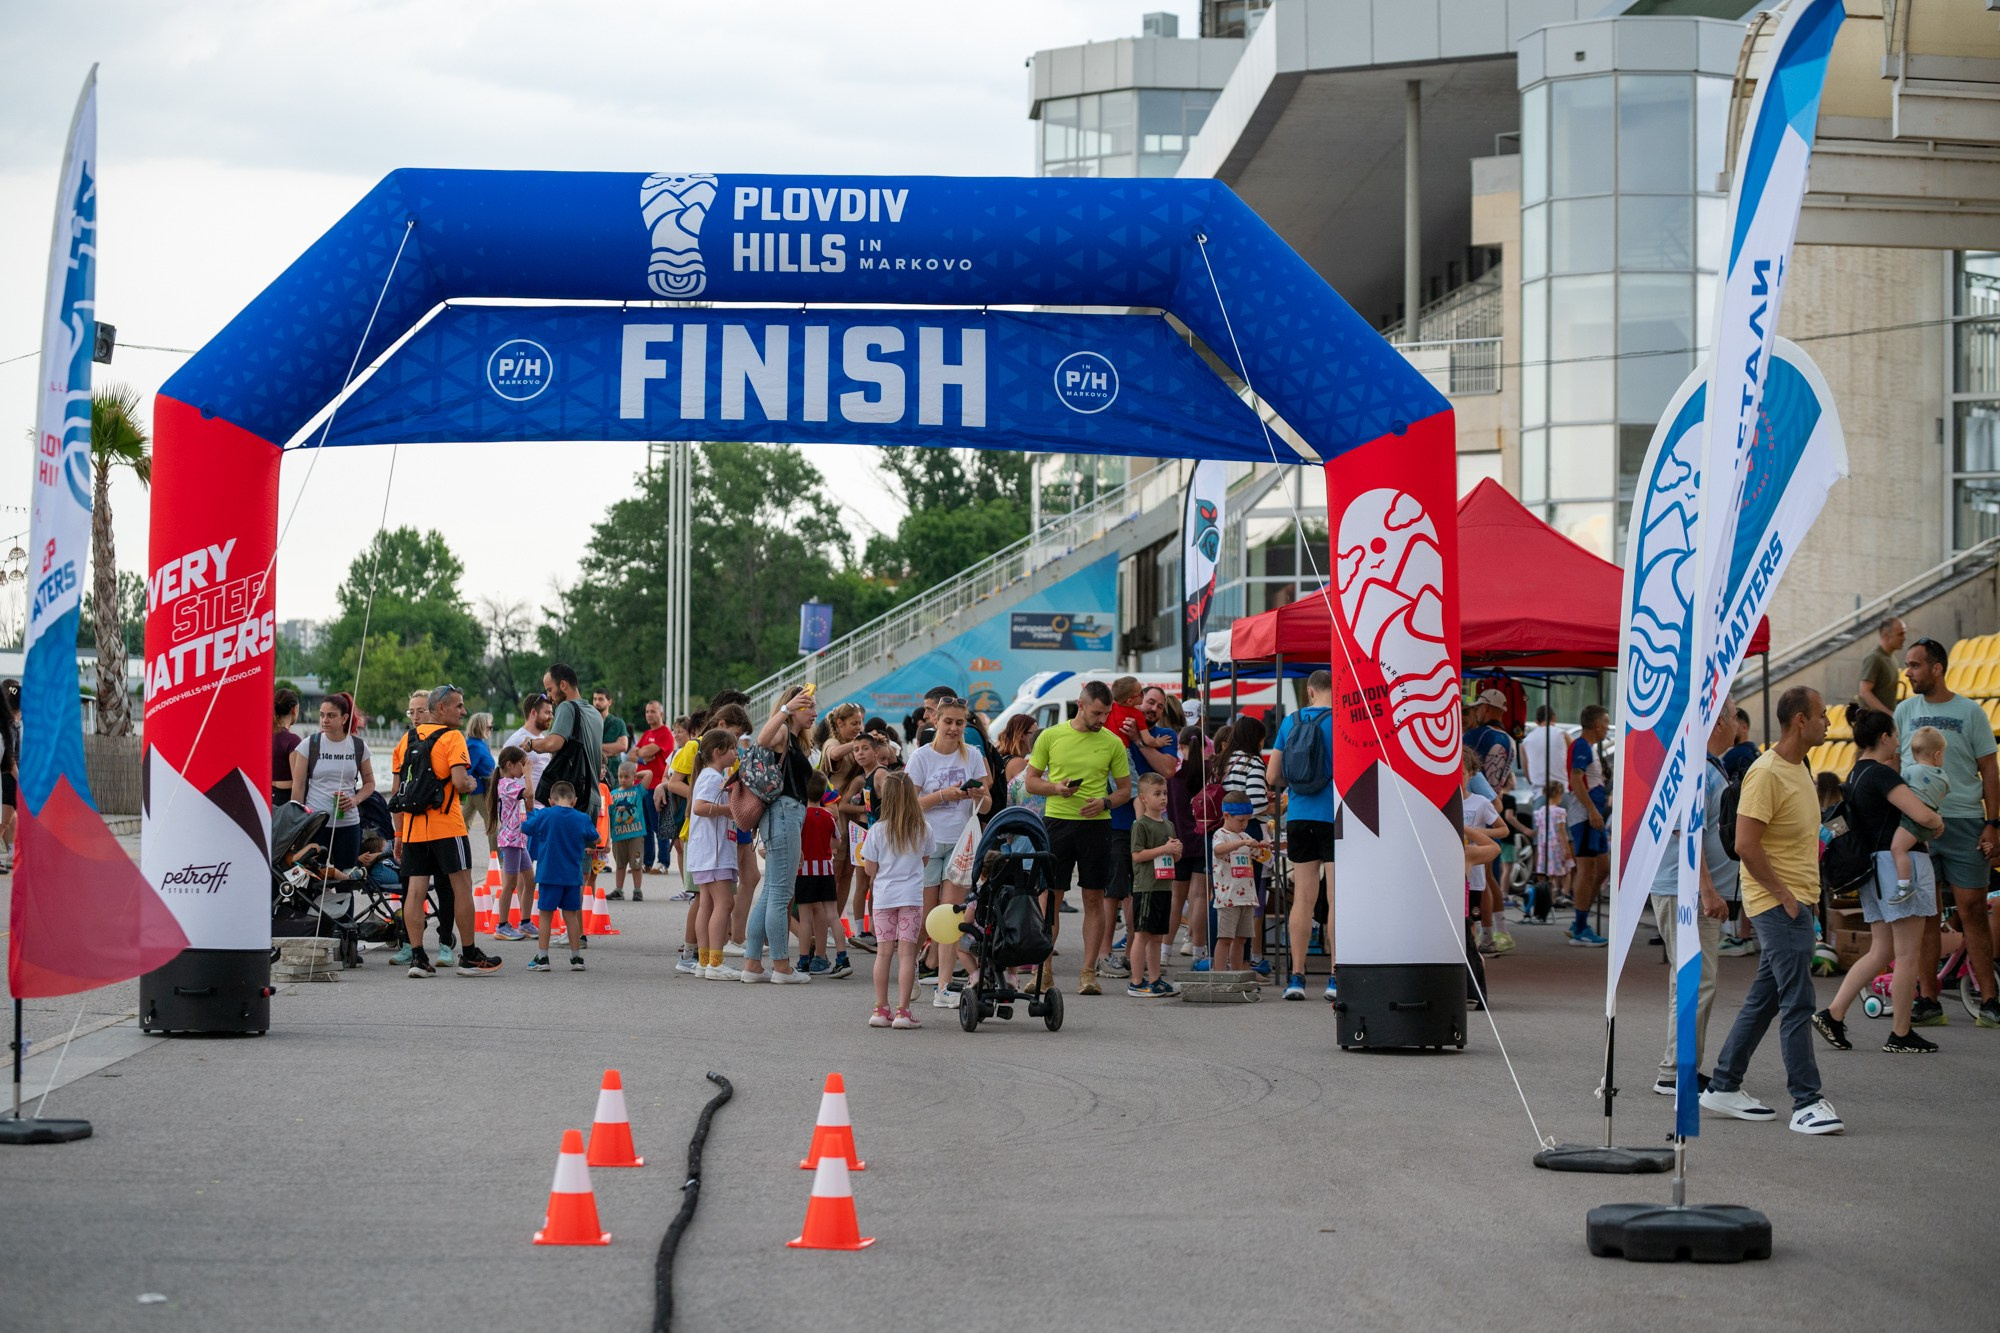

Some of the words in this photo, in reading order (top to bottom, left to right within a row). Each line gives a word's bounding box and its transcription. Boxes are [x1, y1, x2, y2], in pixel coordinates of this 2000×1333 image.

[733, 186, 909, 223] PLOVDIV
[733, 232, 846, 273] HILLS
[859, 239, 883, 252] IN
[859, 257, 974, 271] MARKOVO
[498, 358, 542, 379] P/H
[619, 323, 988, 427] FINISH
[1065, 370, 1107, 390] P/H
[1066, 390, 1108, 398] MARKOVO
[172, 570, 266, 643] STEP
[1716, 530, 1784, 677] MATTERS
[1380, 661, 1409, 700] MARKOVO
[1342, 684, 1389, 709] PLOVDIV
[1350, 703, 1384, 723] HILLS
[1384, 718, 1404, 740] RACE
